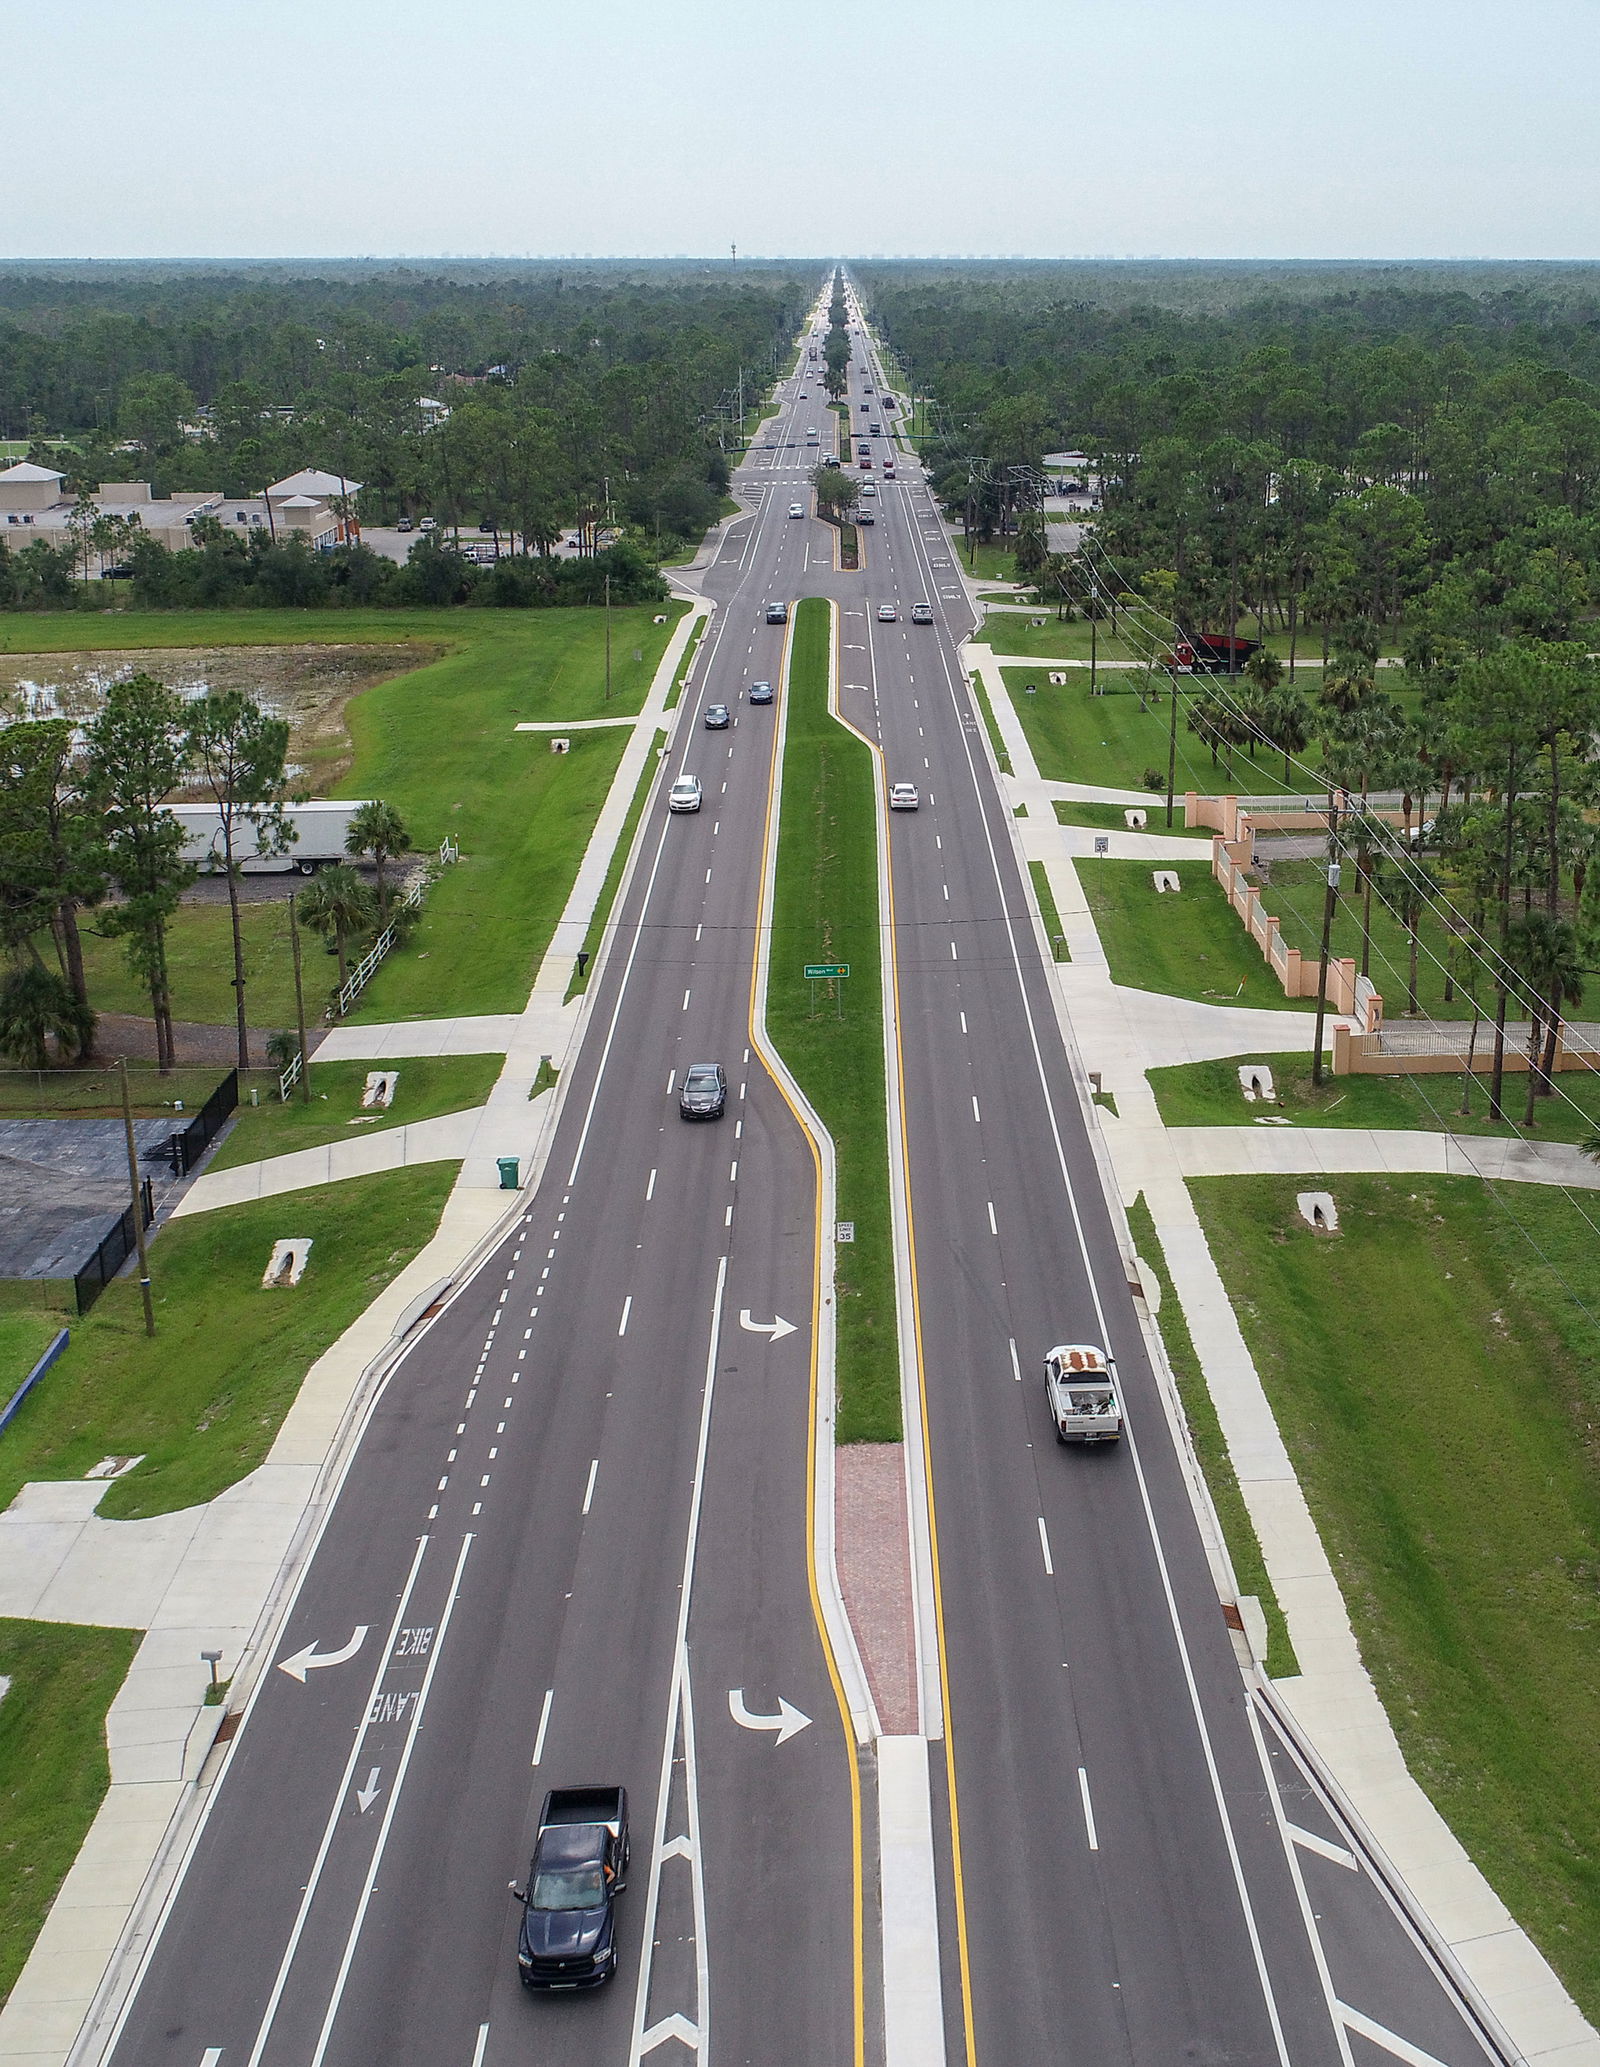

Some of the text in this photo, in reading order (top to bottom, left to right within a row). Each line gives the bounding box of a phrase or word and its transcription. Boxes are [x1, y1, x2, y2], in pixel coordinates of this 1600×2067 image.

[839, 1232, 851, 1240] 35
[395, 1627, 434, 1656] BIKE
[368, 1692, 420, 1723] LANE
